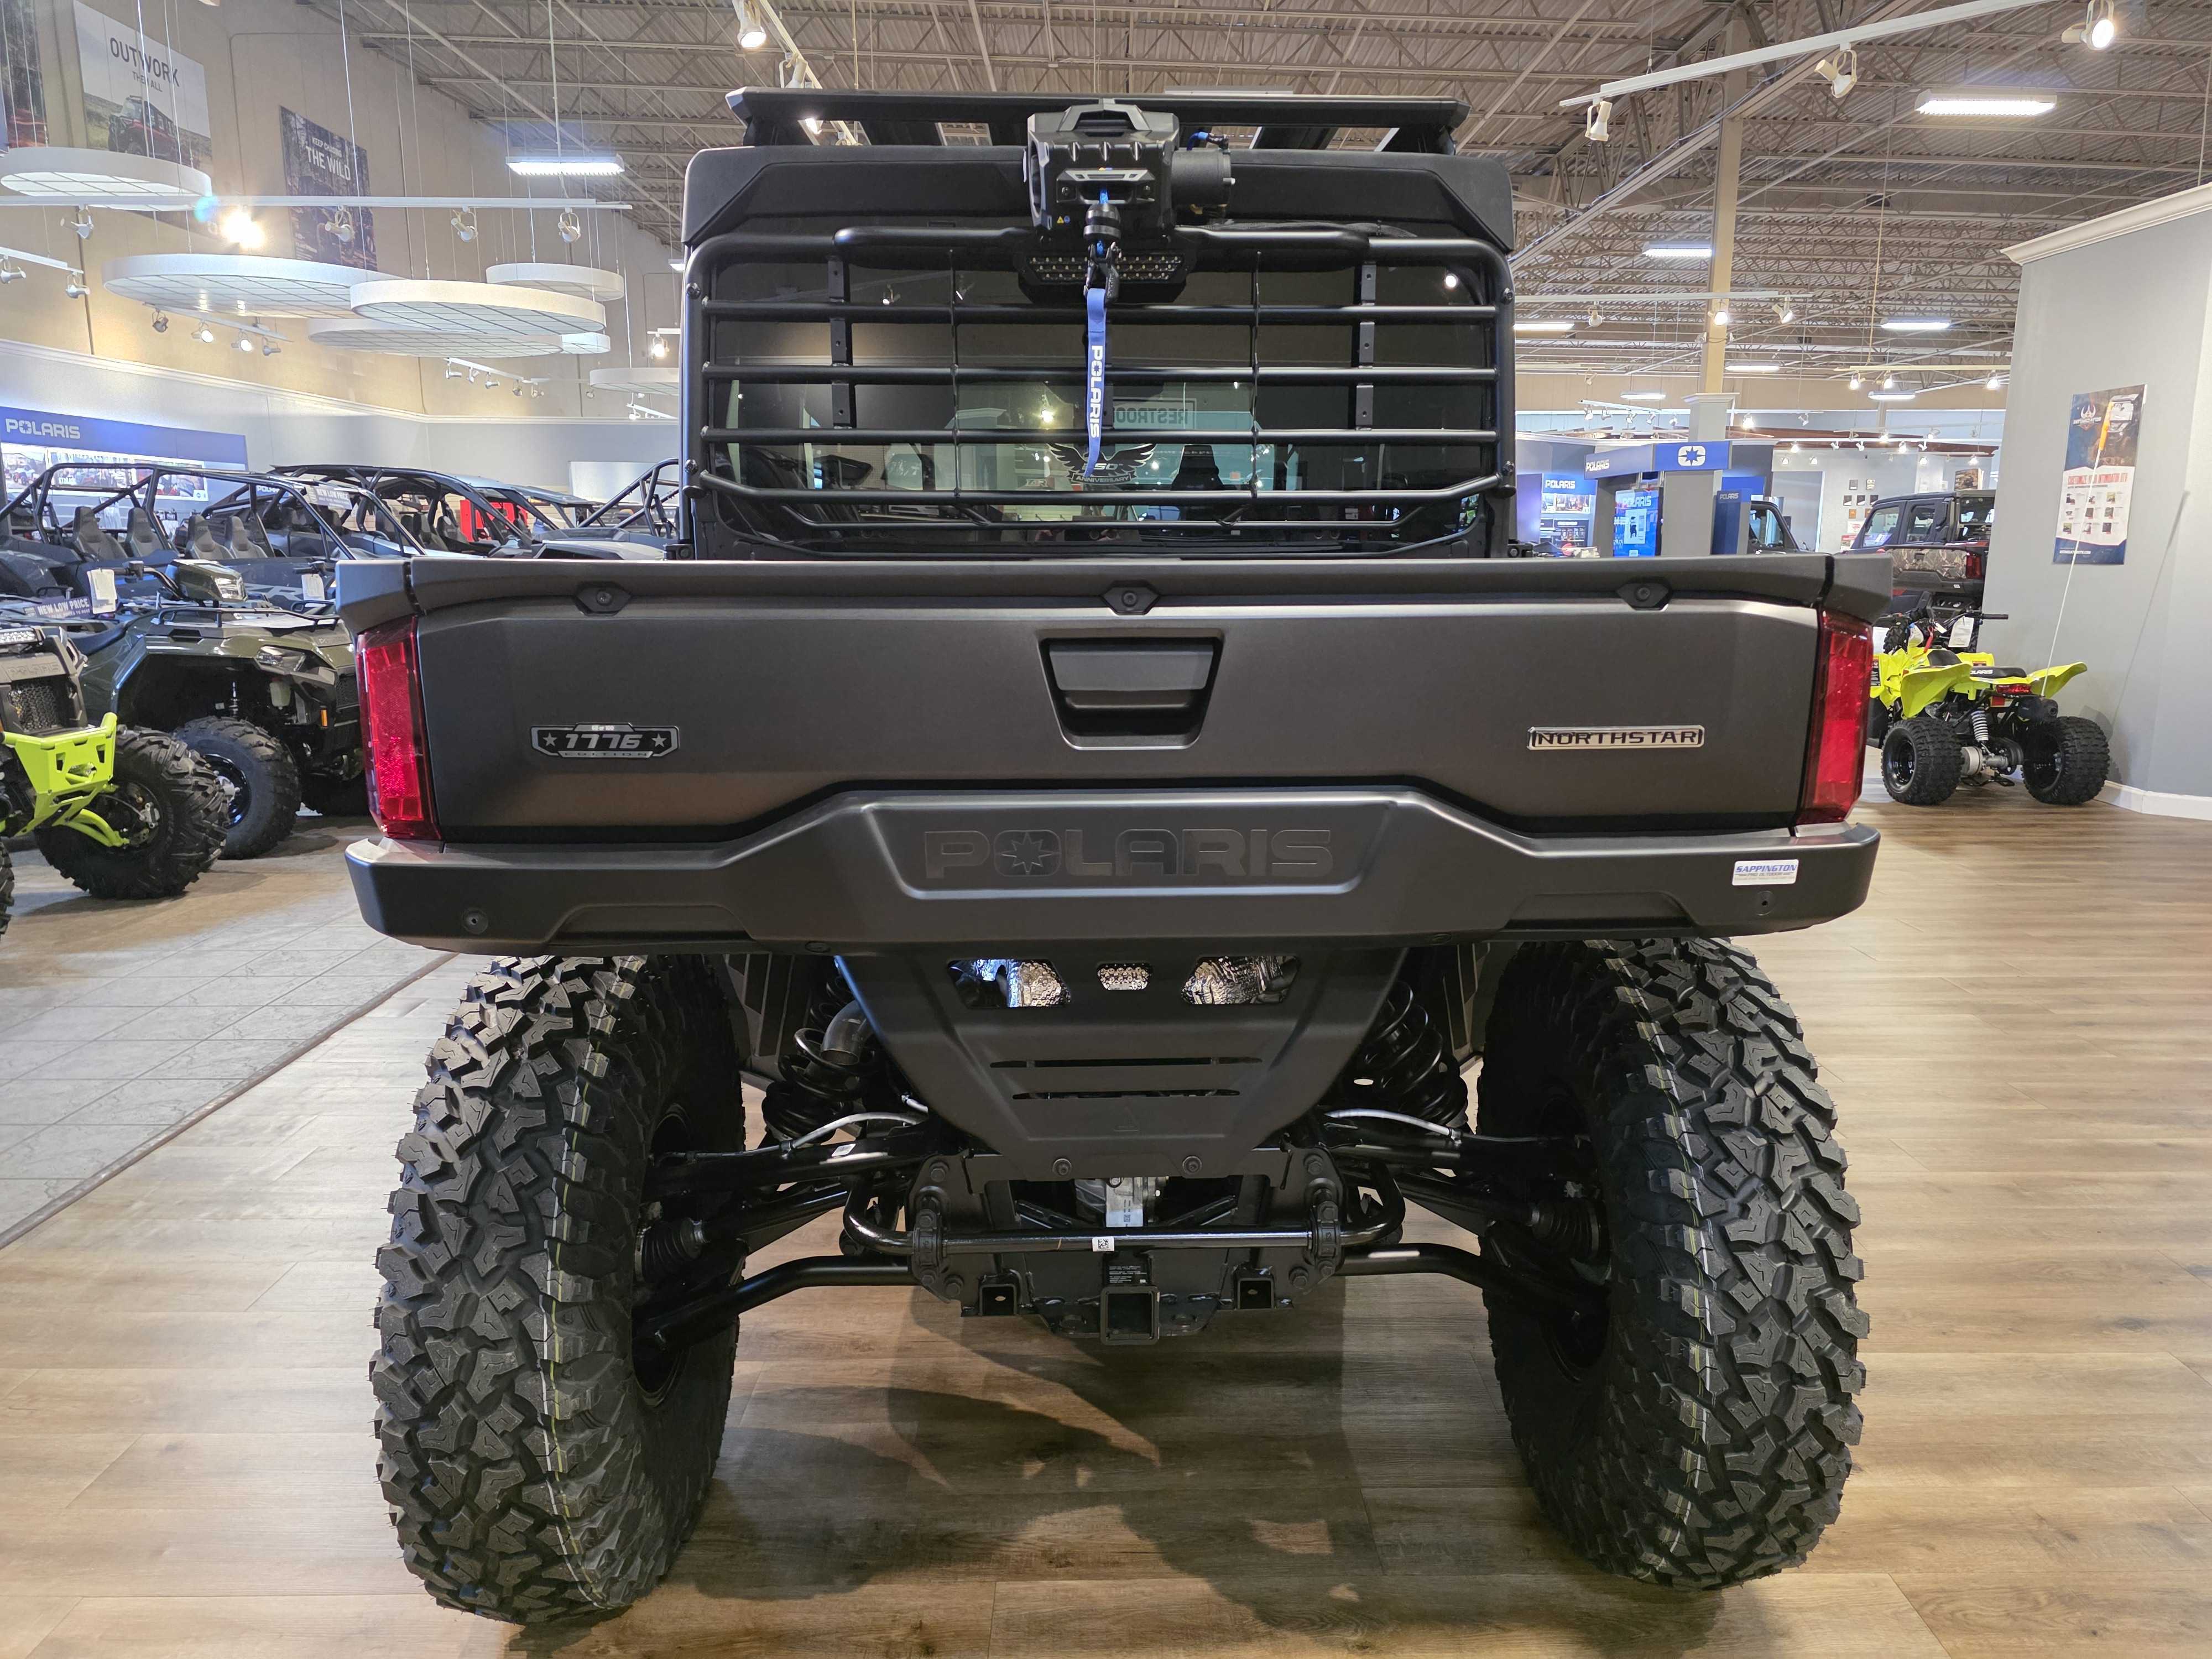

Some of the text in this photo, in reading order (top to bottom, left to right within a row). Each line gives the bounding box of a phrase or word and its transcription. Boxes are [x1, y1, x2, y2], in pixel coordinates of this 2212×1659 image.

[110, 38, 180, 87] OUTWORK
[151, 80, 163, 92] ALL
[312, 137, 323, 147] KEEP
[306, 145, 351, 180] THE WILD
[1091, 345, 1103, 438] POLARIS
[6, 419, 81, 439] POLARIS
[1585, 460, 1610, 471] POLARIS
[1545, 480, 1575, 489] POLARIS
[37, 603, 54, 615] NEW
[54, 601, 69, 612] LOW
[70, 598, 90, 609] PRICE
[566, 734, 643, 749] 1776
[1538, 731, 1697, 745] NORTHSTAR
[924, 828, 1334, 878] POLARIS
[1735, 864, 1797, 873] SAPPINGTON
